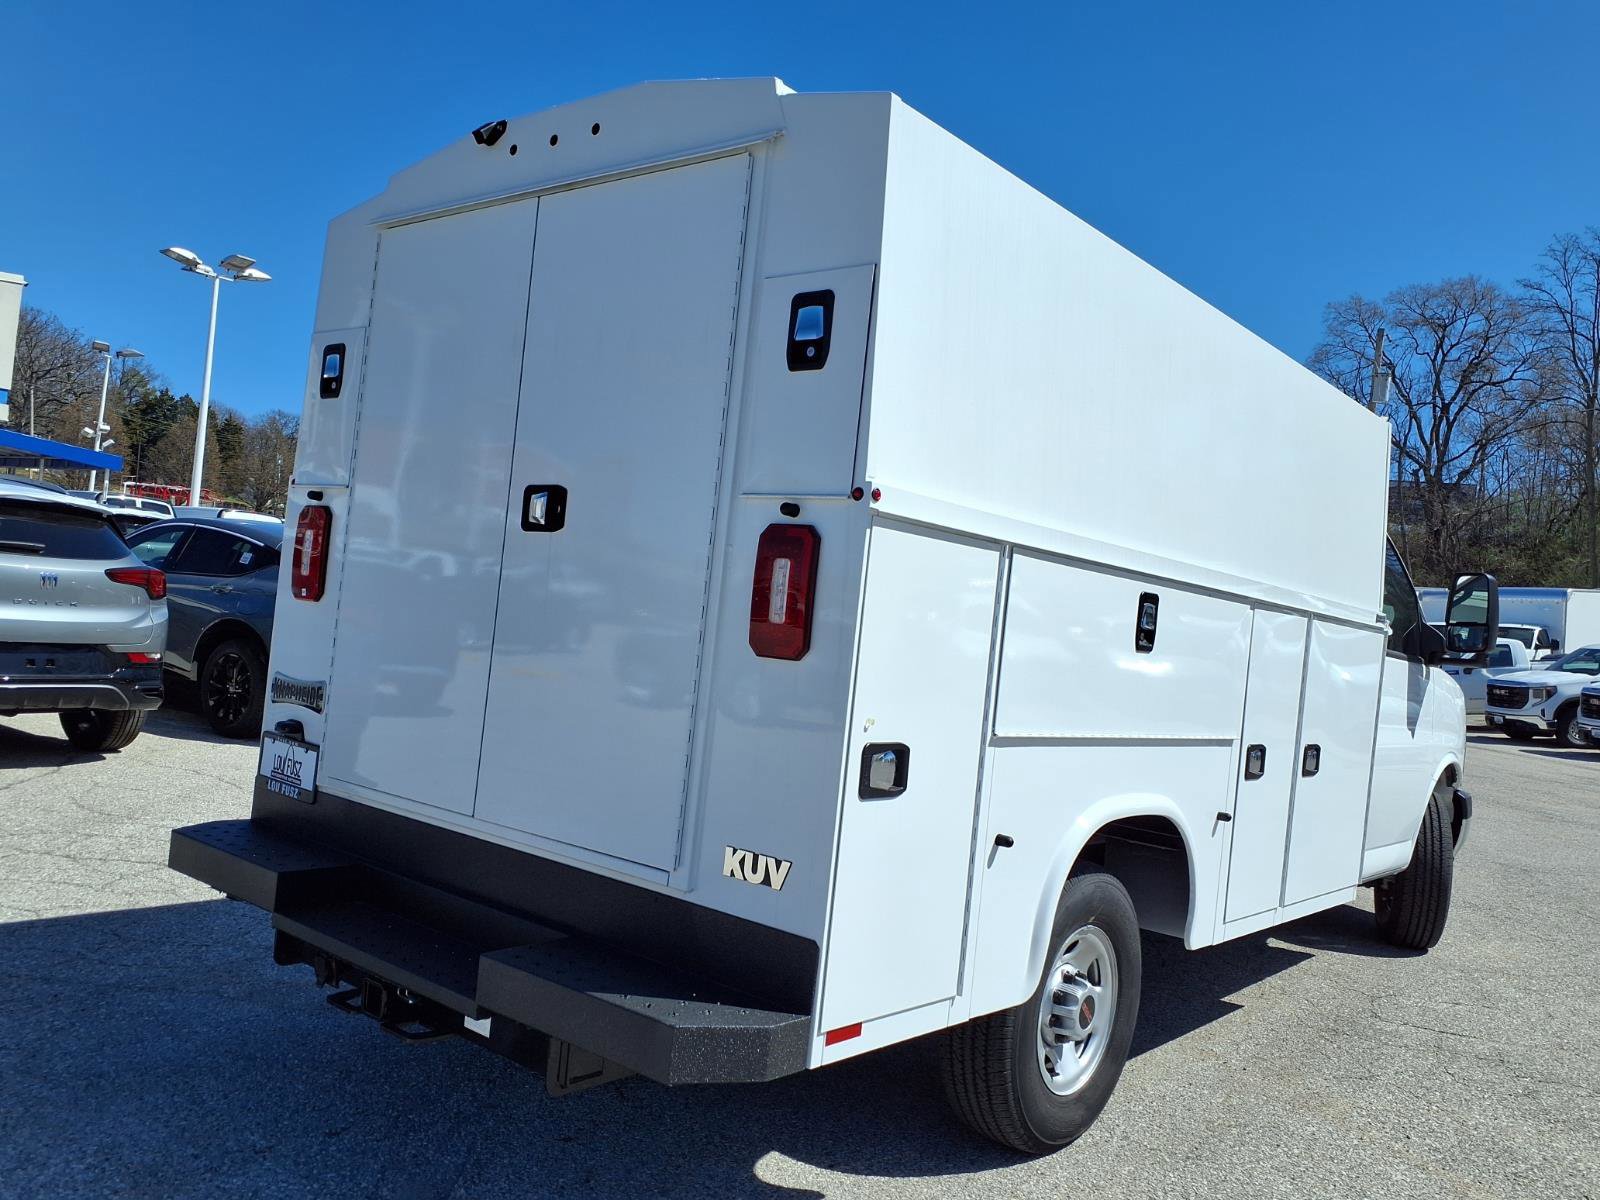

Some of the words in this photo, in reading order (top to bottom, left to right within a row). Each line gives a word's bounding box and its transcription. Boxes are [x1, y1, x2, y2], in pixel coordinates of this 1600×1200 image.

[273, 753, 286, 773] LOU
[286, 758, 302, 778] FUSZ
[267, 778, 281, 793] LOU
[281, 784, 300, 799] FUSZ
[722, 845, 792, 891] KUV
